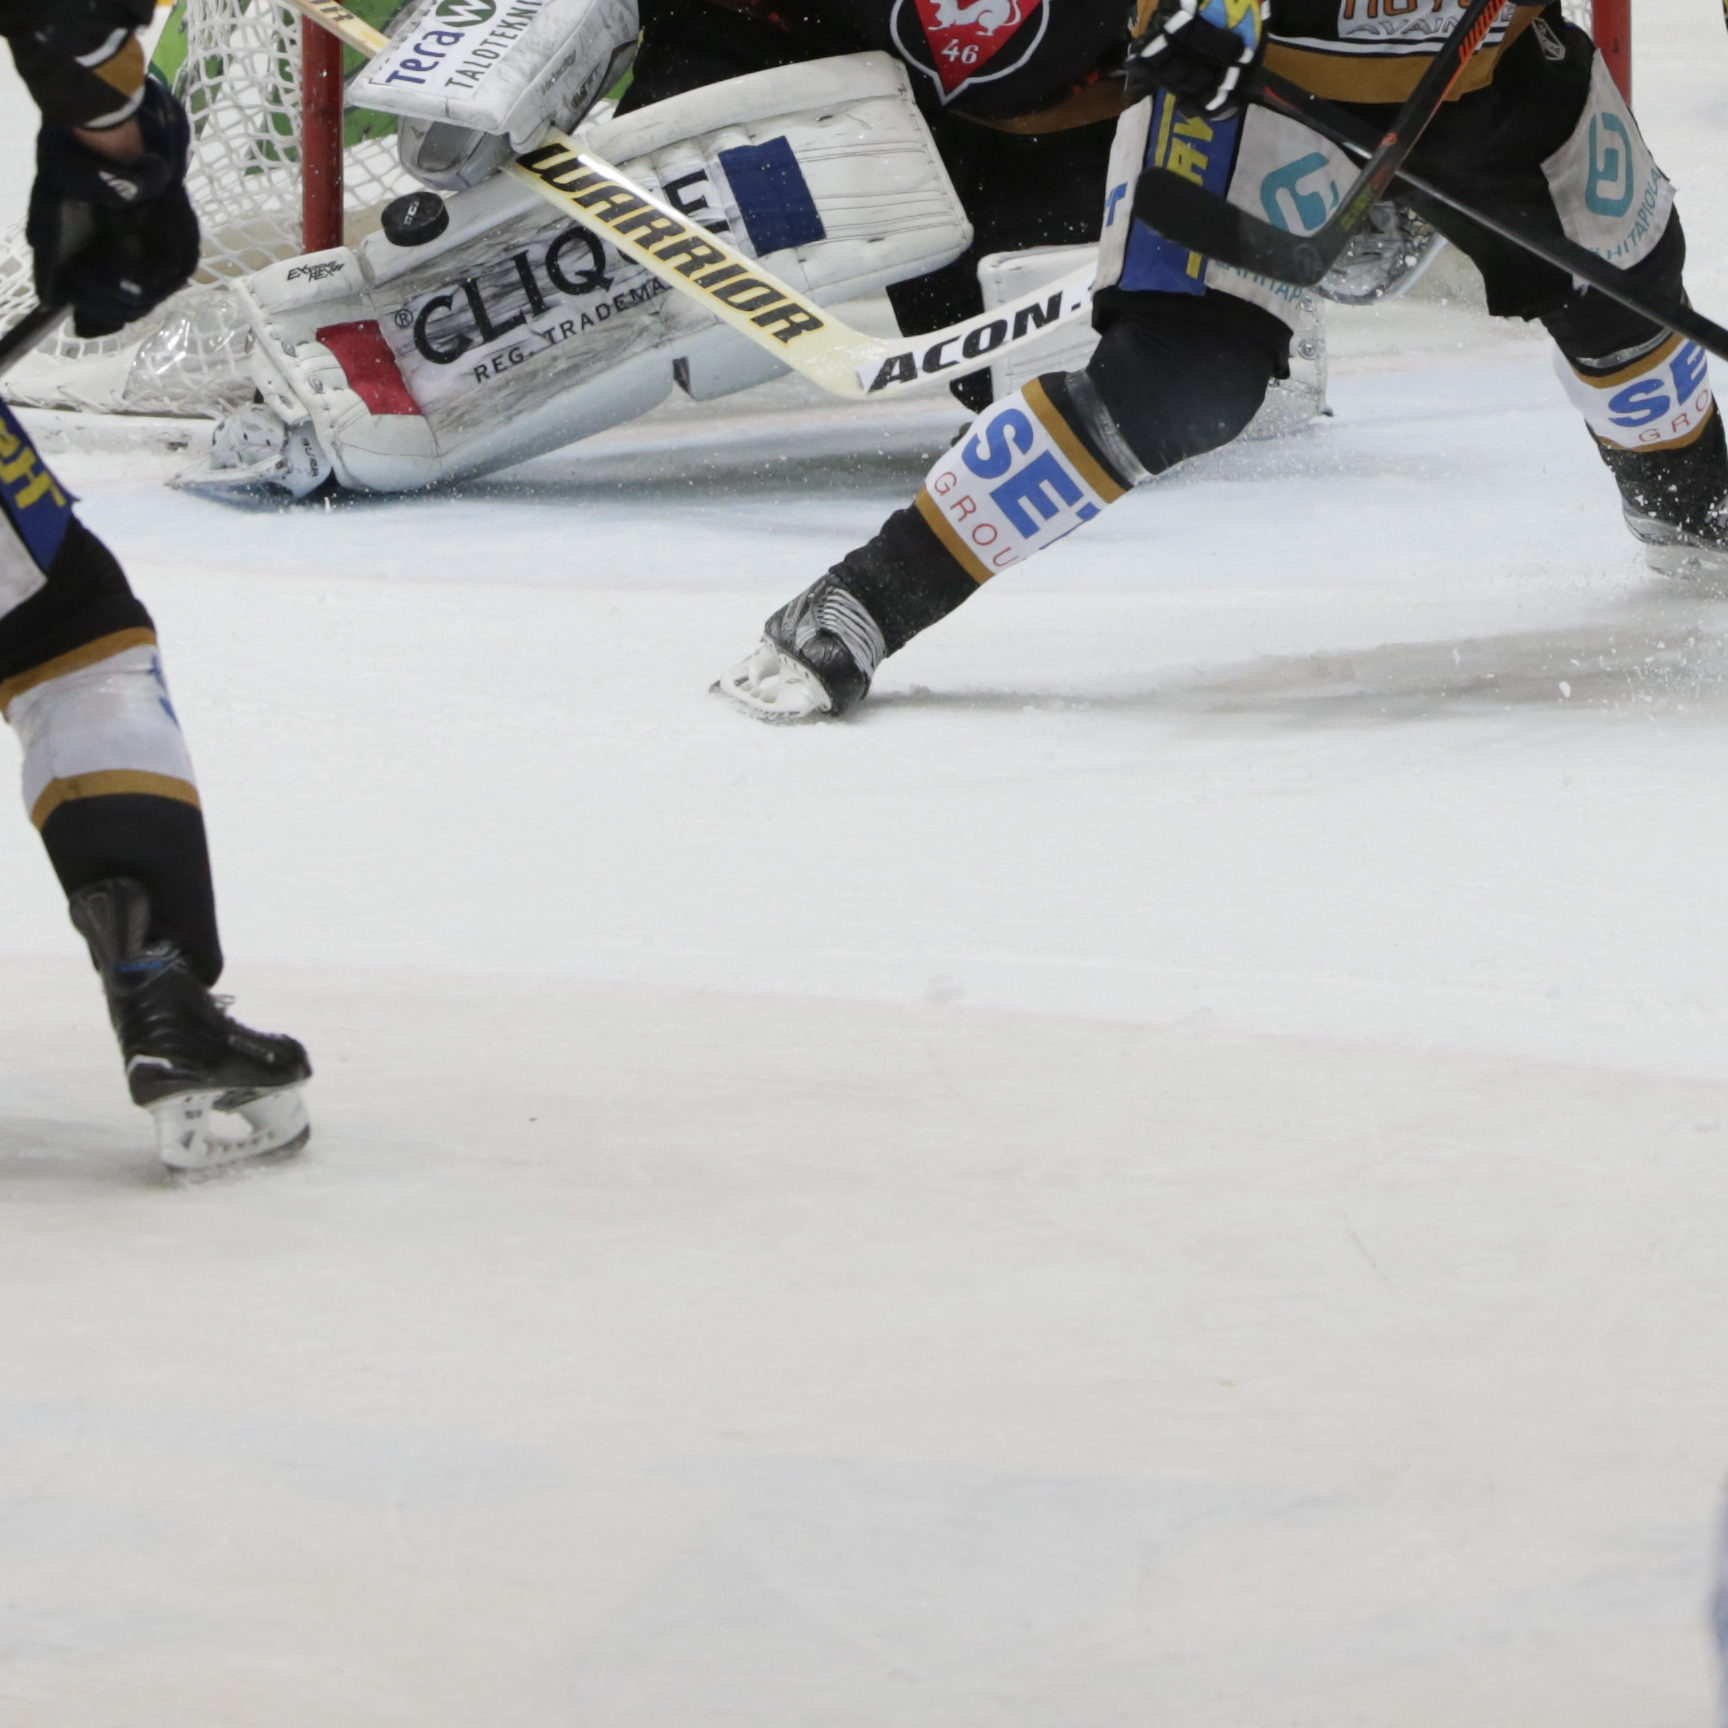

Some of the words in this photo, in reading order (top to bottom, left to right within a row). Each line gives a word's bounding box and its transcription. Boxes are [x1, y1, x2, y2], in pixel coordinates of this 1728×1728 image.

[941, 38, 980, 65] 46
[516, 140, 826, 345] WARRIOR
[473, 348, 536, 384] REG.
